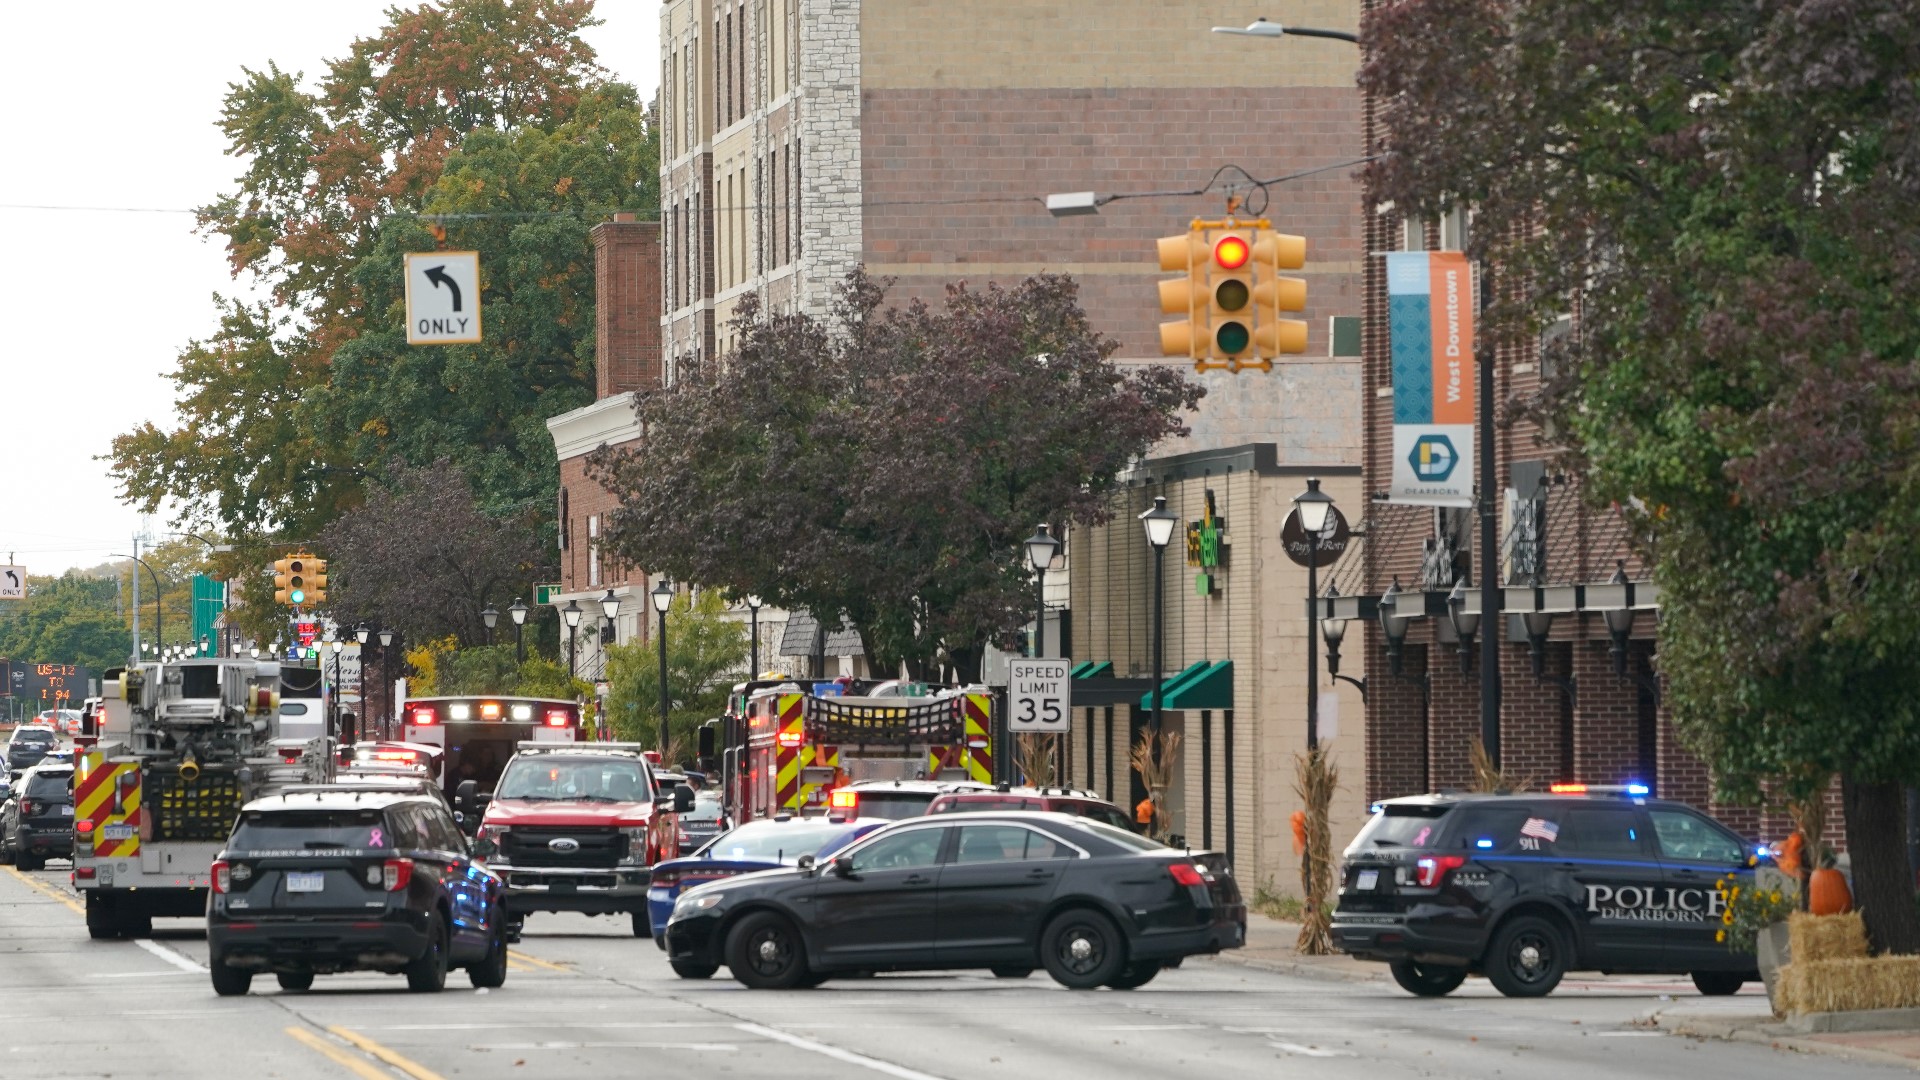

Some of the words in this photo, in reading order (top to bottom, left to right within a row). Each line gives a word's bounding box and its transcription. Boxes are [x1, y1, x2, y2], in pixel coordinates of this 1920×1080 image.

[1446, 269, 1460, 357] Downtown
[418, 318, 469, 335] ONLY
[1446, 360, 1461, 404] West
[1404, 488, 1460, 496] DEARBORN
[2, 588, 21, 596] ONLY
[37, 663, 75, 676] US-12
[1015, 667, 1065, 679] SPEED
[48, 676, 64, 687] TO
[41, 688, 70, 700] I-94
[1020, 682, 1059, 694] LIMIT
[1017, 697, 1062, 723] 35
[1518, 837, 1541, 851] 911
[314, 849, 364, 857] POLICE
[1601, 907, 1705, 923] DEARBORN
